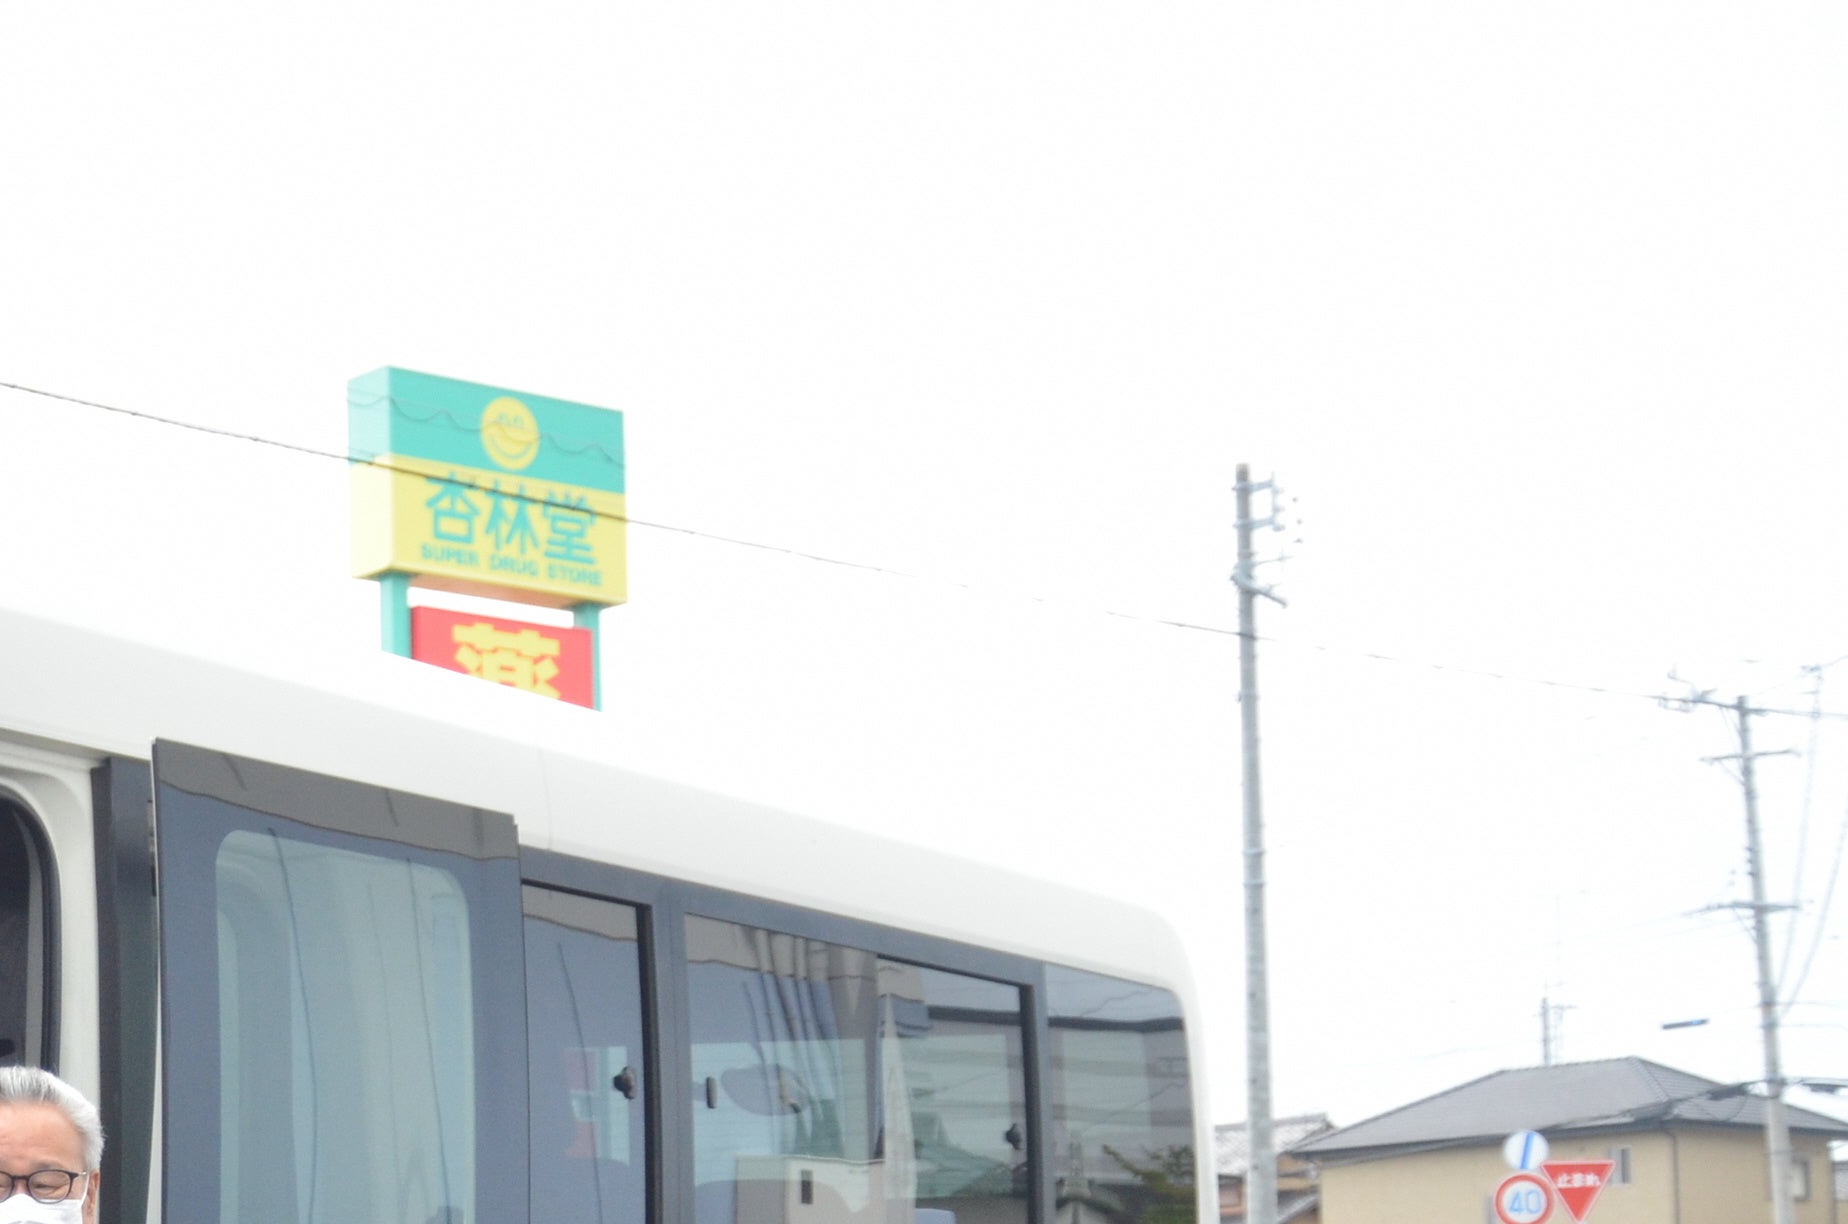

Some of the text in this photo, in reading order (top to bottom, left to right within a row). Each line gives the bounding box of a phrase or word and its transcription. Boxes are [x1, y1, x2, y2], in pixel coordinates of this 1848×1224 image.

[424, 471, 598, 566] 杏林堂
[421, 543, 602, 586] SUPER DRUG STORE
[1509, 1190, 1542, 1214] 40
